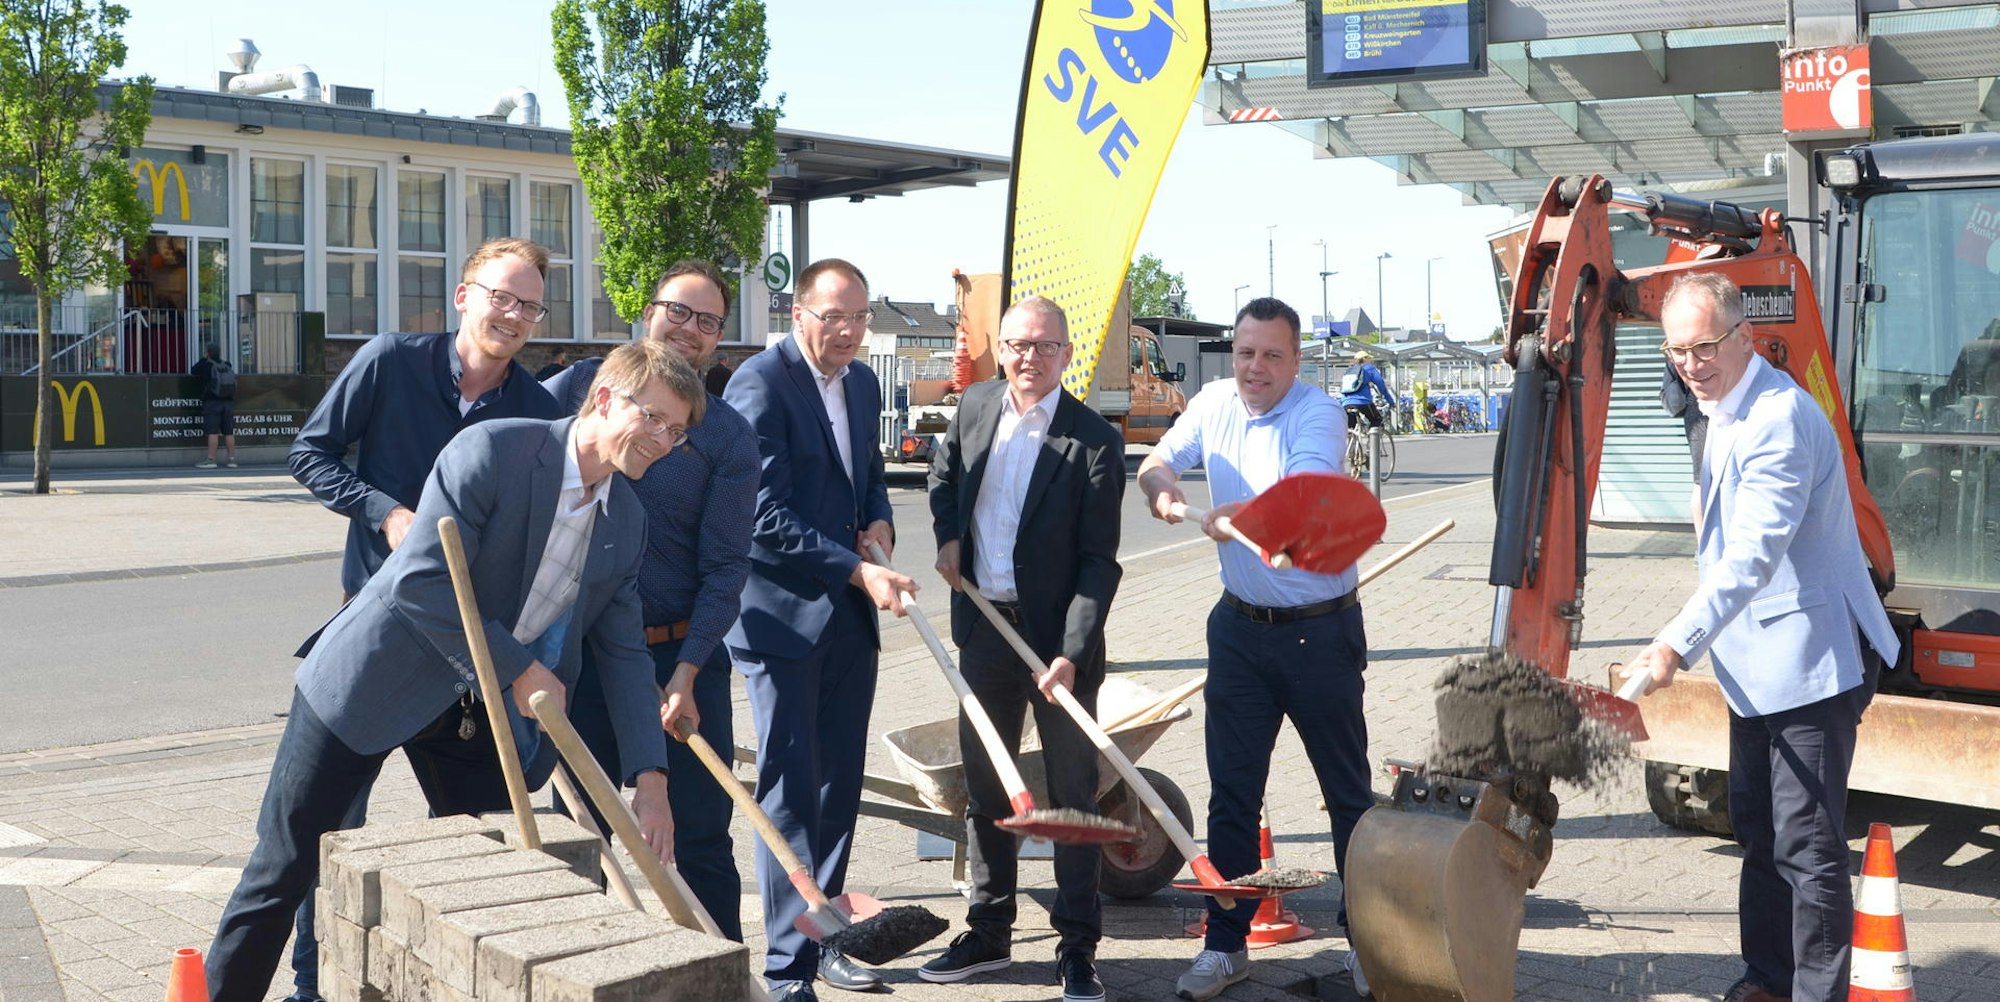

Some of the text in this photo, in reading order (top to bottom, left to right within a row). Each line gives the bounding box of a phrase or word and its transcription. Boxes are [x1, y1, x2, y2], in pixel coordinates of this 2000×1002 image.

[1363, 30, 1422, 39] Kreuzweingarten
[1784, 78, 1832, 93] Punkt
[1043, 48, 1140, 179] SVE
[767, 256, 786, 289] S
[152, 397, 203, 407] GEÖFFNET:
[153, 416, 193, 425] MONTAG
[194, 416, 204, 424] BI
[254, 415, 266, 423] AB
[273, 414, 293, 422] UHR
[153, 429, 182, 438] SONN-
[183, 429, 204, 437] UND
[254, 427, 268, 435] AB
[268, 427, 279, 435] 10
[280, 427, 300, 435] UHR
